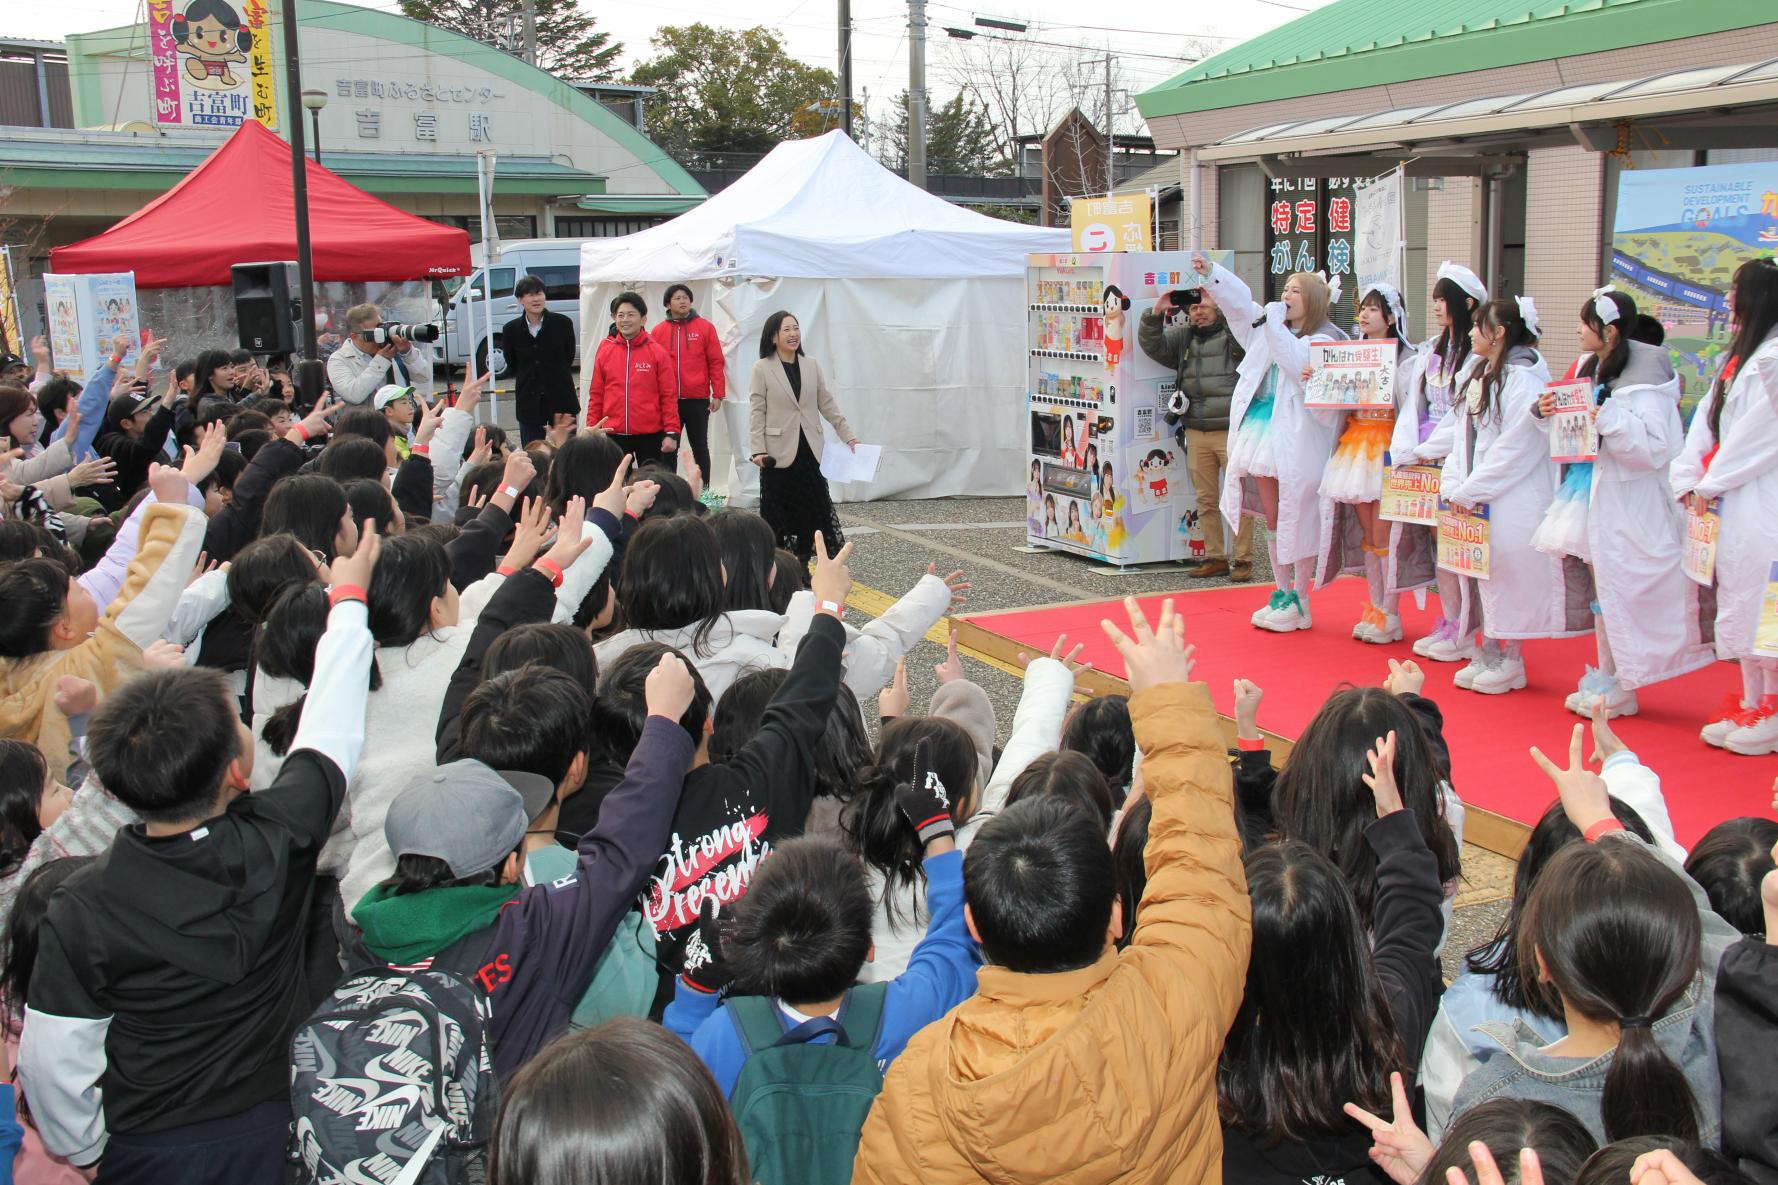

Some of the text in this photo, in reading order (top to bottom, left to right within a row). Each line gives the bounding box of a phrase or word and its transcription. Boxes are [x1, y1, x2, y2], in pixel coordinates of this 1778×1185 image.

[187, 90, 248, 115] 吉富町
[335, 78, 506, 104] 吉富町ふるさとセンター
[355, 108, 493, 142] 吉富駅
[1683, 193, 1750, 206] DEVELOPMENT
[1684, 181, 1753, 194] SUSTAINABLE
[1682, 204, 1749, 228] GOALS
[365, 1021, 420, 1050] NIKE
[311, 1082, 364, 1116] NIKE
[354, 1103, 409, 1131] NIKE
